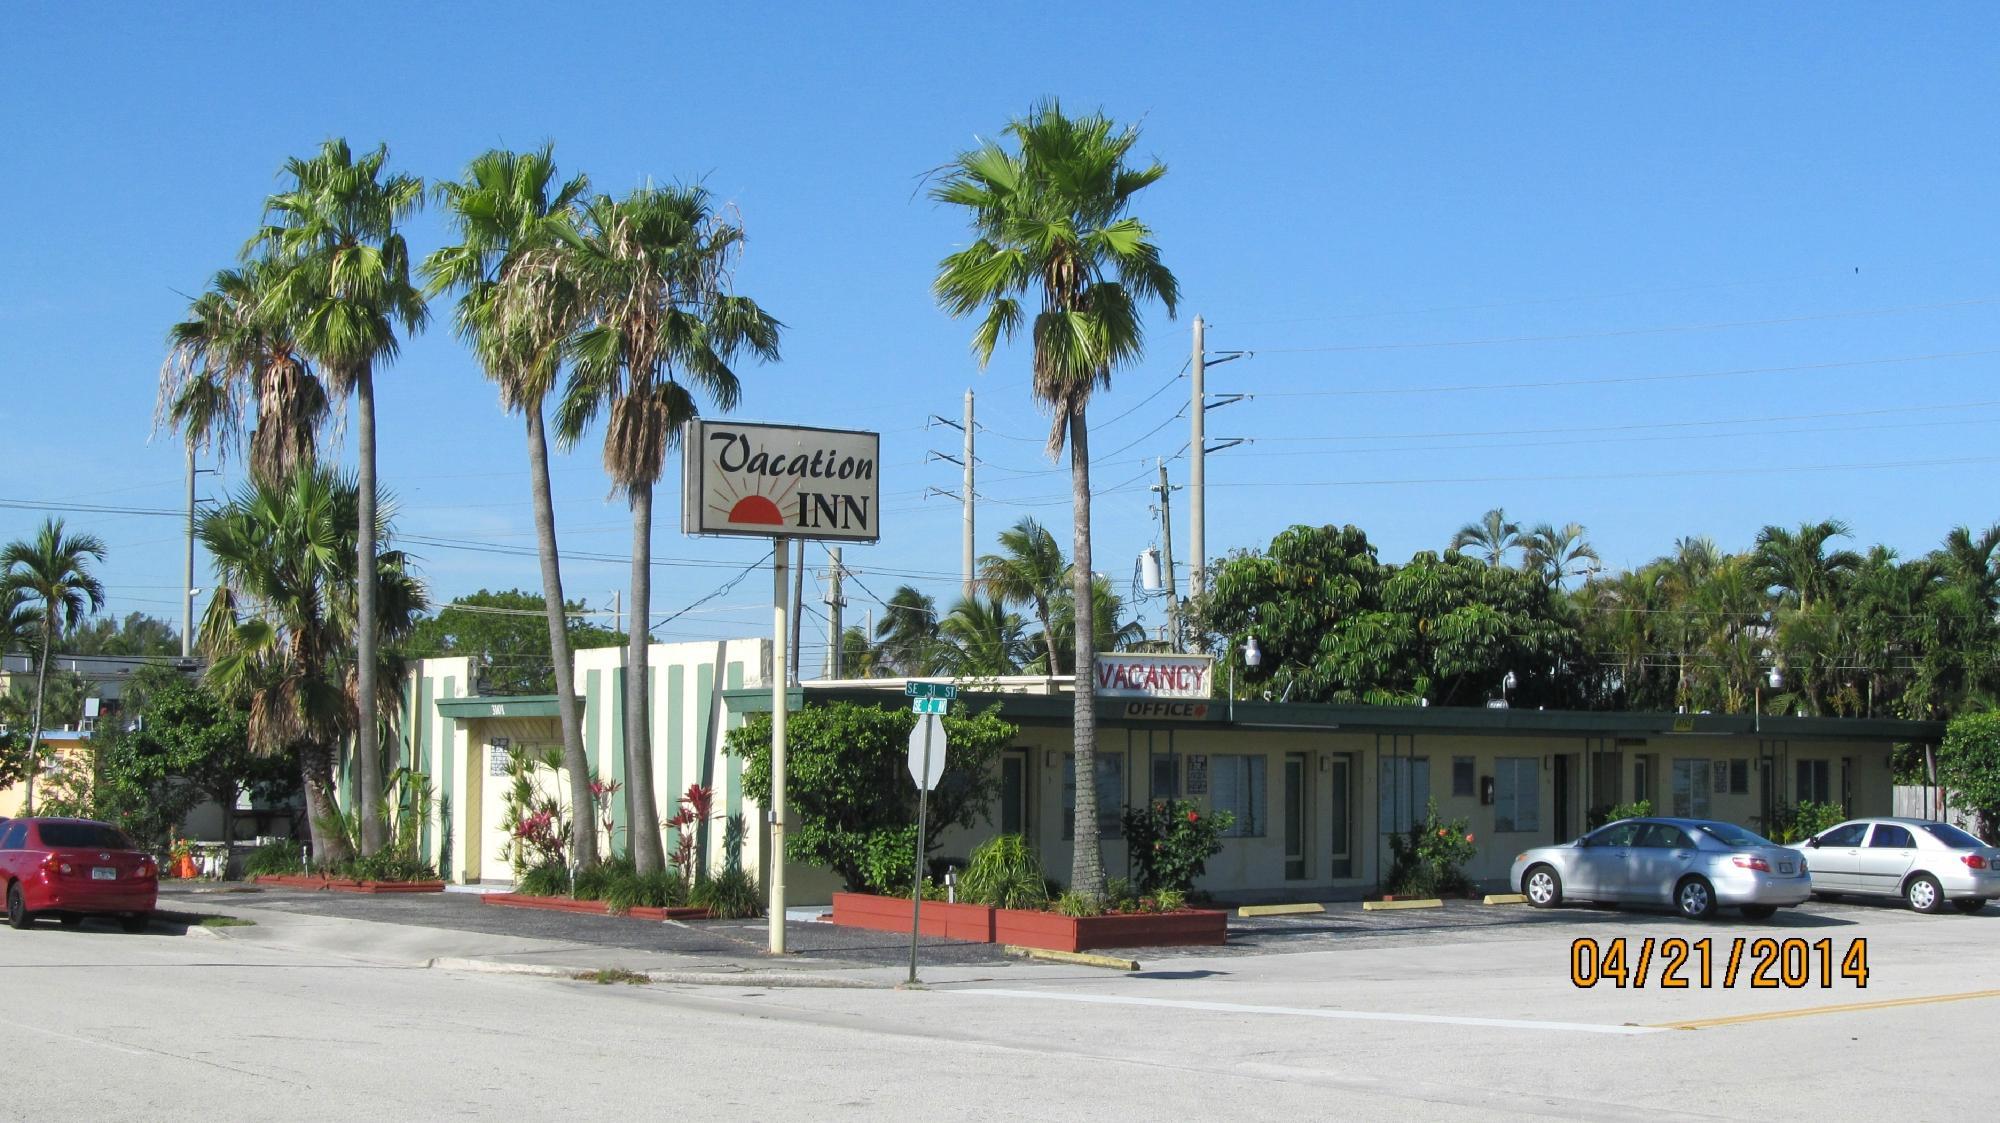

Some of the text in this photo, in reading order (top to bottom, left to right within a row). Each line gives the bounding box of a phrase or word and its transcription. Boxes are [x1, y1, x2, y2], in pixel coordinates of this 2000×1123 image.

[710, 432, 873, 480] Vacation
[796, 492, 870, 530] INN
[1097, 660, 1208, 690] VACANCY
[907, 682, 955, 698] SE 31 ST
[914, 699, 922, 712] SE
[1127, 702, 1194, 717] OFFICE
